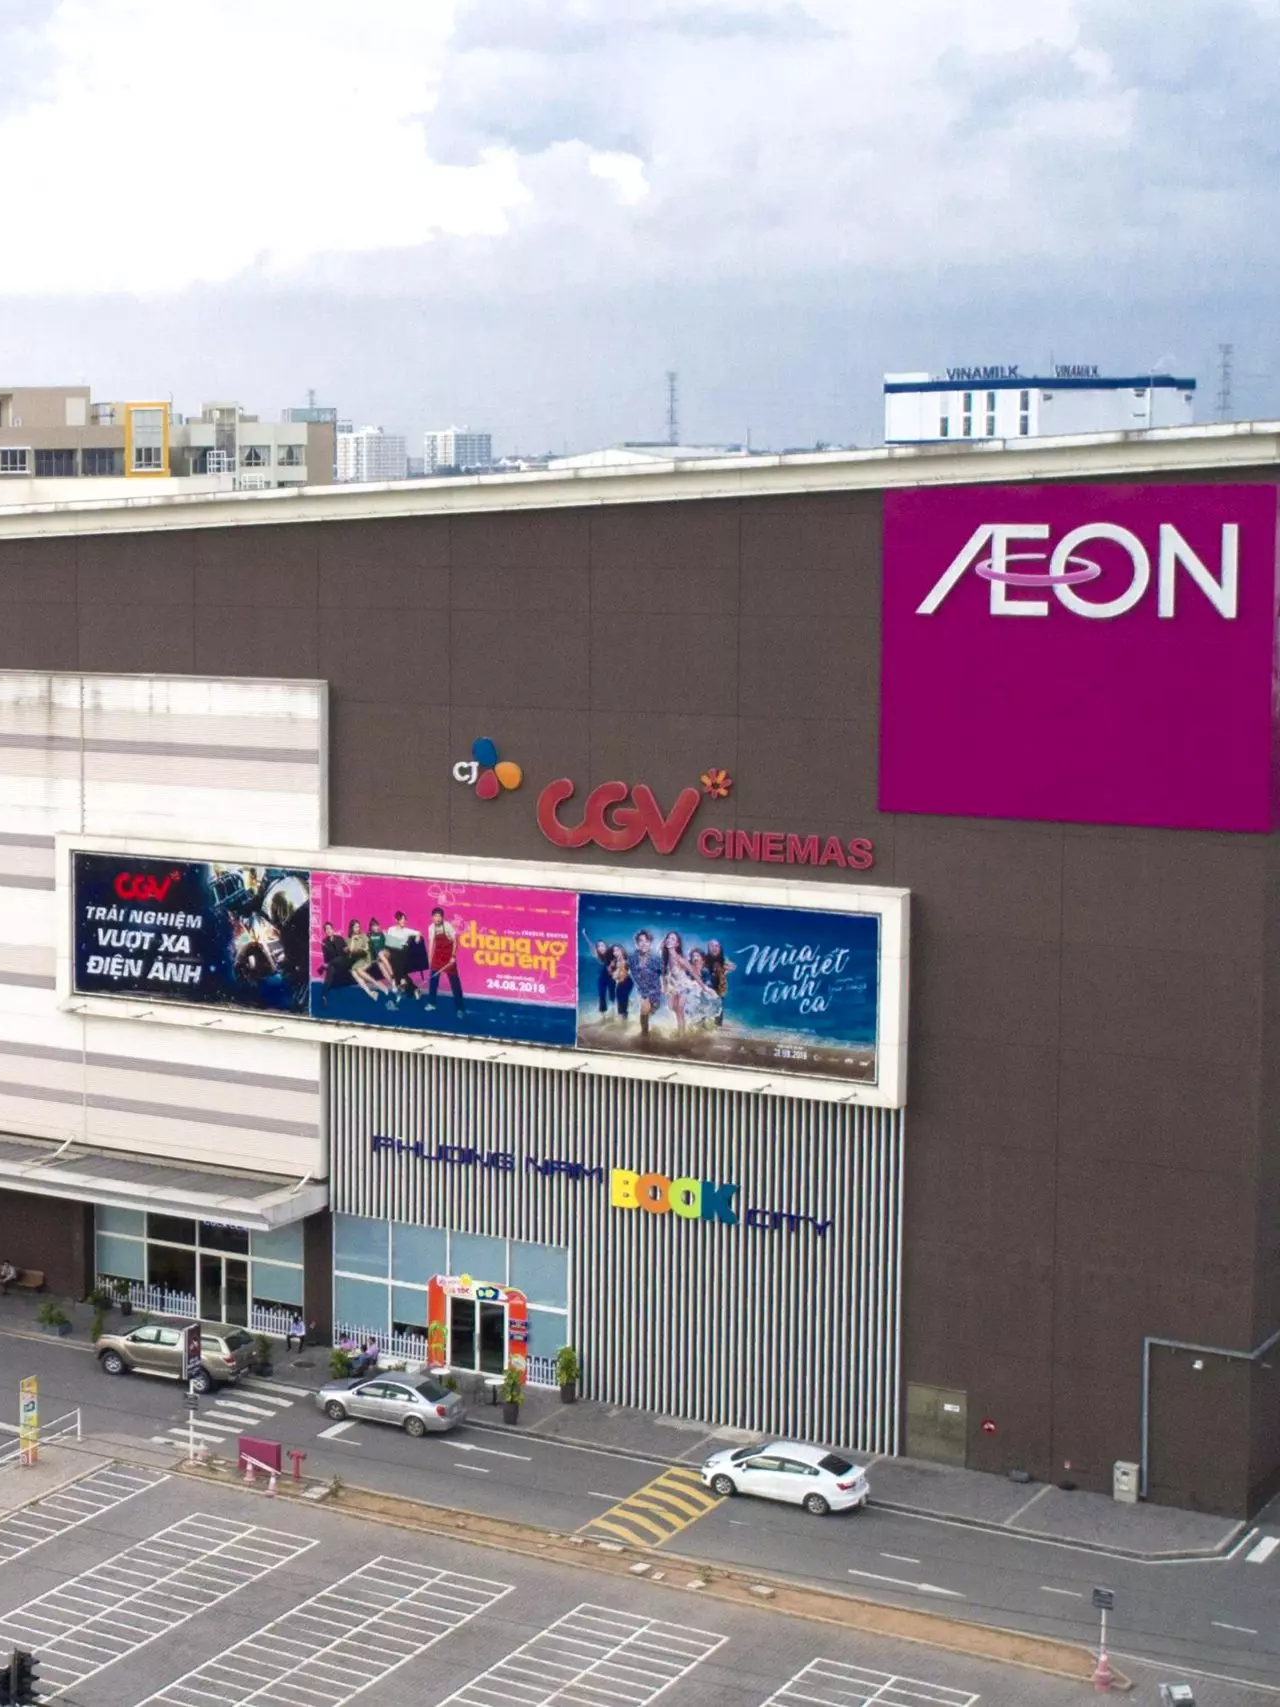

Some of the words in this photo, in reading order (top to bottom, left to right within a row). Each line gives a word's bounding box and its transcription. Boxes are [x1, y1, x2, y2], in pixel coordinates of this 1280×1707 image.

[945, 365, 1019, 381] VINAMILK
[452, 761, 479, 784] CJ
[536, 778, 701, 855] CGV
[698, 828, 874, 870] CINEMAS
[114, 871, 172, 902] CGV
[128, 910, 203, 930] NGHIỆM
[97, 927, 155, 953] VƯỢT
[157, 933, 190, 954] XA
[86, 954, 143, 980] ĐIỆN
[147, 956, 202, 984] ẢNH
[733, 944, 820, 975] Mùa
[486, 978, 546, 994] 24.08.2018
[799, 995, 833, 1015] ca
[611, 1167, 741, 1226] BOOK
